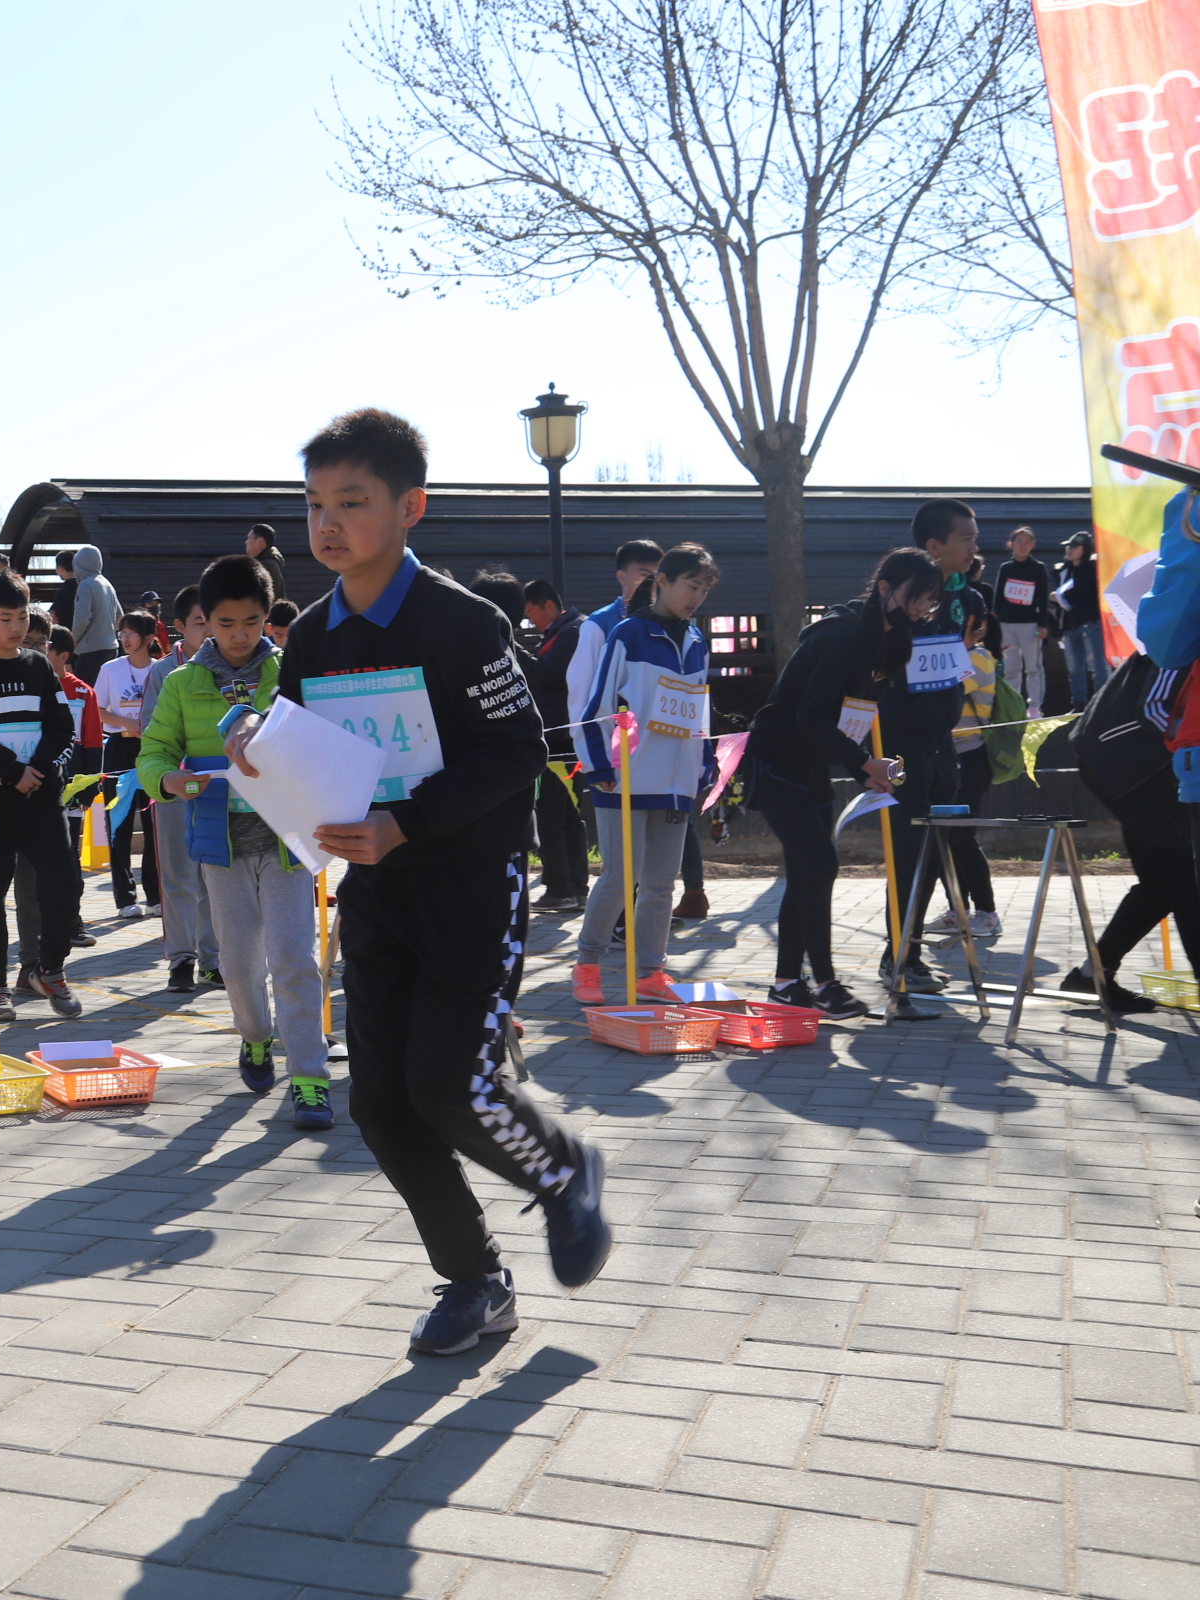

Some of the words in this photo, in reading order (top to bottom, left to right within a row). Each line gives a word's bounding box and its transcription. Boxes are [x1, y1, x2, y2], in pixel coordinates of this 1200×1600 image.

[482, 656, 511, 677] PURSE
[919, 652, 957, 672] 2001
[466, 685, 481, 698] ME
[480, 671, 513, 693] WORLD
[487, 703, 517, 719] SINCE
[661, 696, 697, 720] 2203
